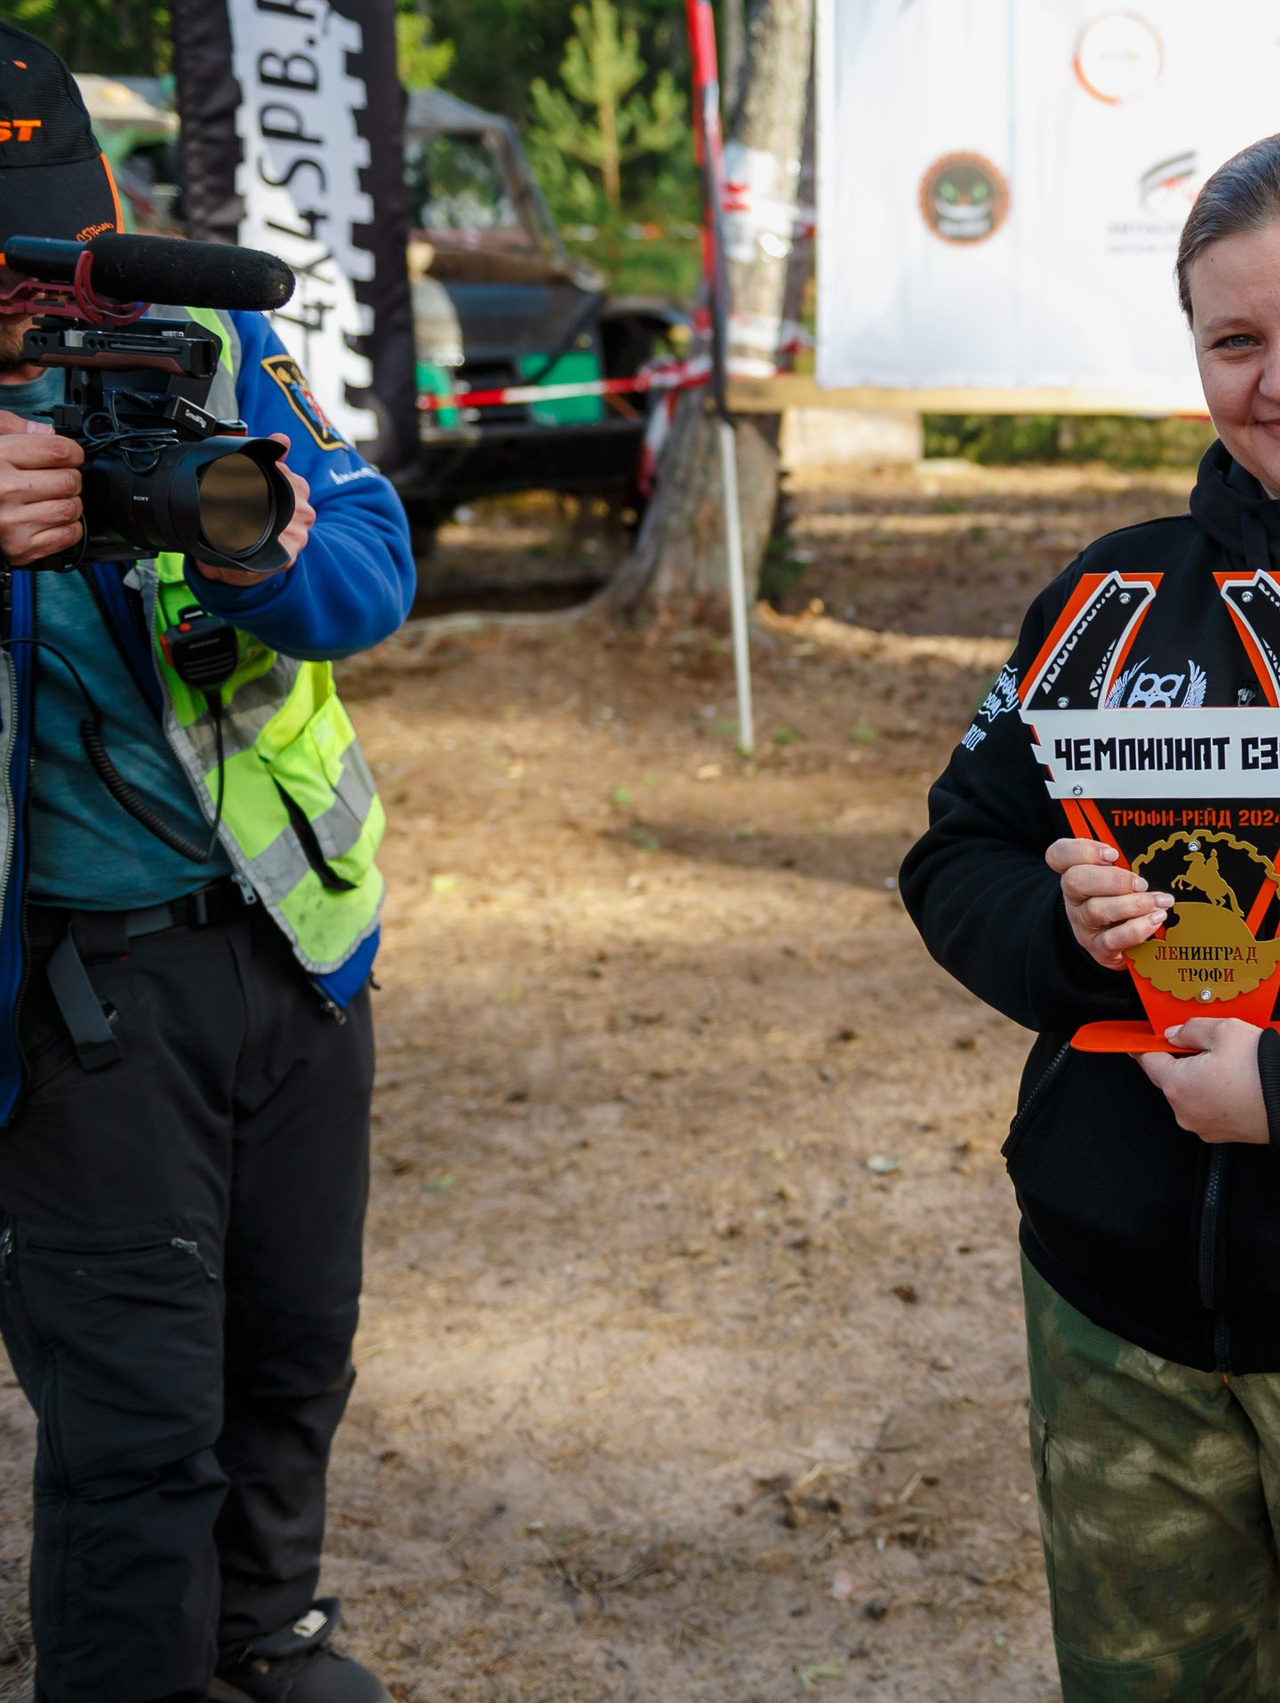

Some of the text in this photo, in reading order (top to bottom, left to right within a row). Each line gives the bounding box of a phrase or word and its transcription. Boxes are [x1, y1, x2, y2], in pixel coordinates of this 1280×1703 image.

[1054, 735, 1230, 772] ЧЕМПИОНАТ
[1111, 807, 1232, 829] ТРОФИ-РЕЙД
[1154, 945, 1258, 964] ЛЕНИНГРАД
[1177, 967, 1235, 983] ТРОФИ
